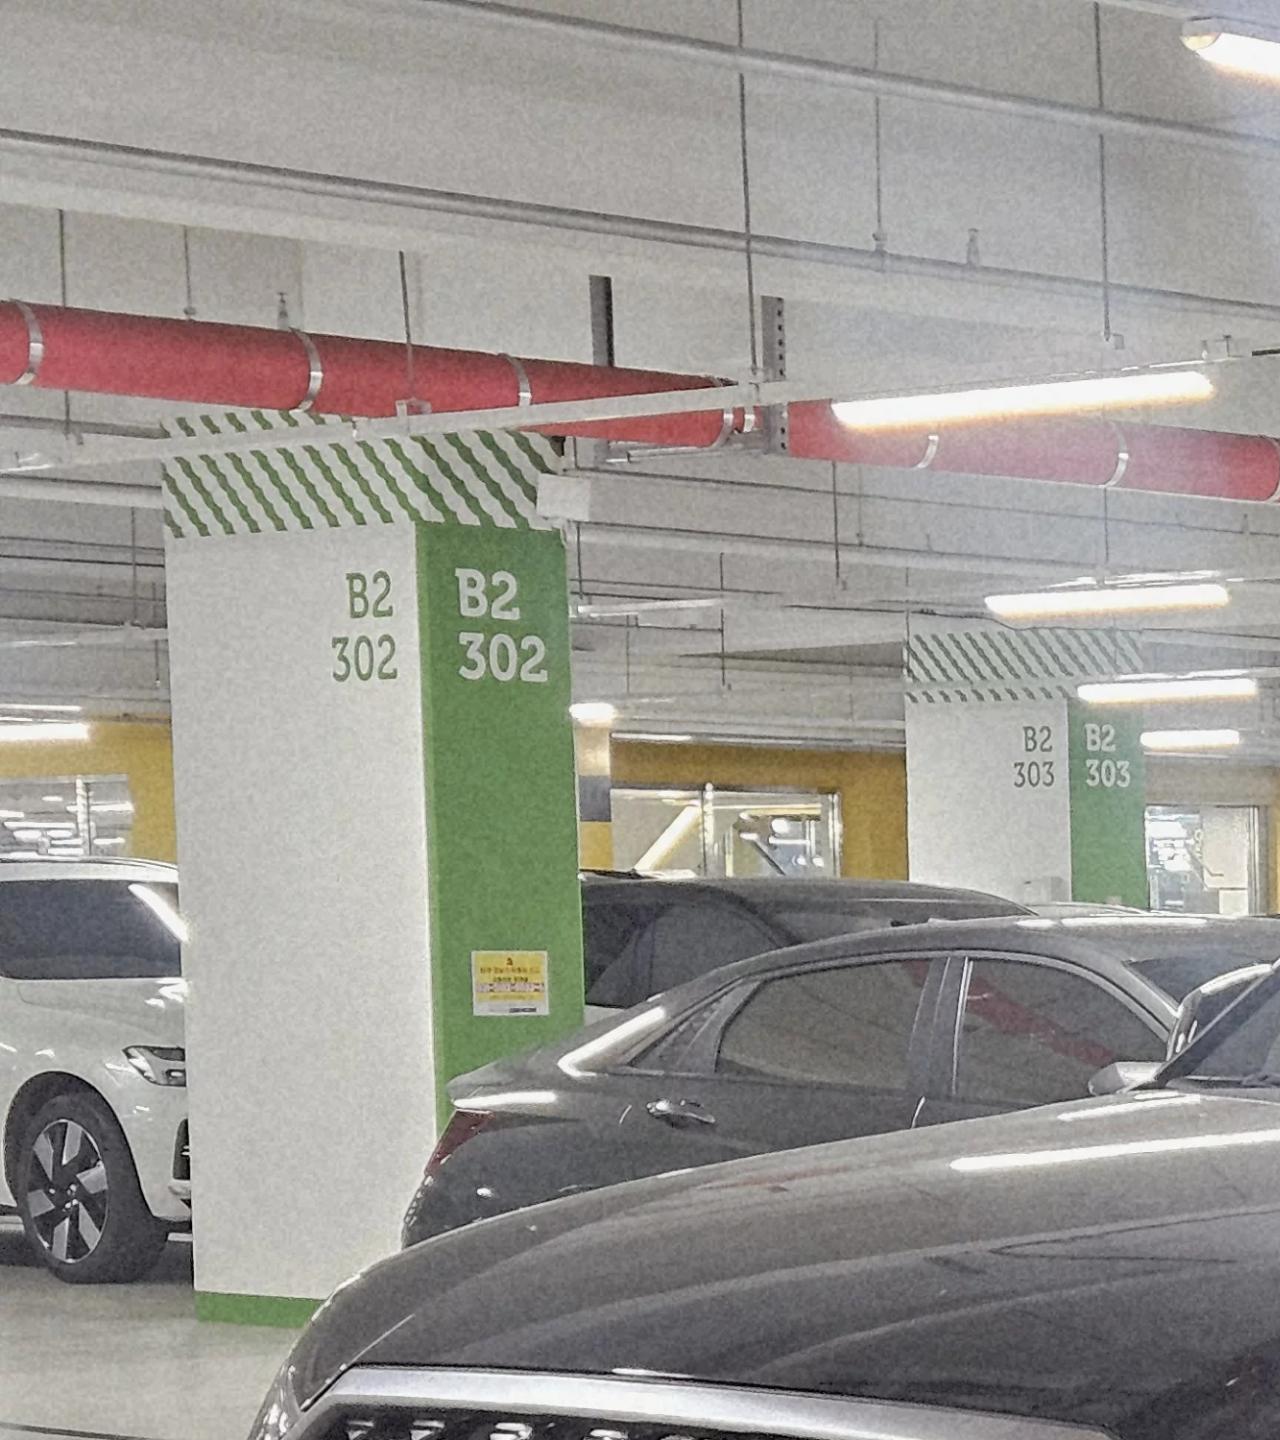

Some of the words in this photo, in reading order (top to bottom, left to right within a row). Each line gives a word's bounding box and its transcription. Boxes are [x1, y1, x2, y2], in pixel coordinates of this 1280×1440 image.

[345, 570, 394, 620] B2
[455, 568, 521, 622] B2
[331, 633, 398, 682] 302
[458, 632, 549, 683] 302
[1022, 725, 1054, 753] B2
[1084, 722, 1117, 753] B2
[1013, 761, 1055, 789] 303
[1085, 759, 1131, 789] 303
